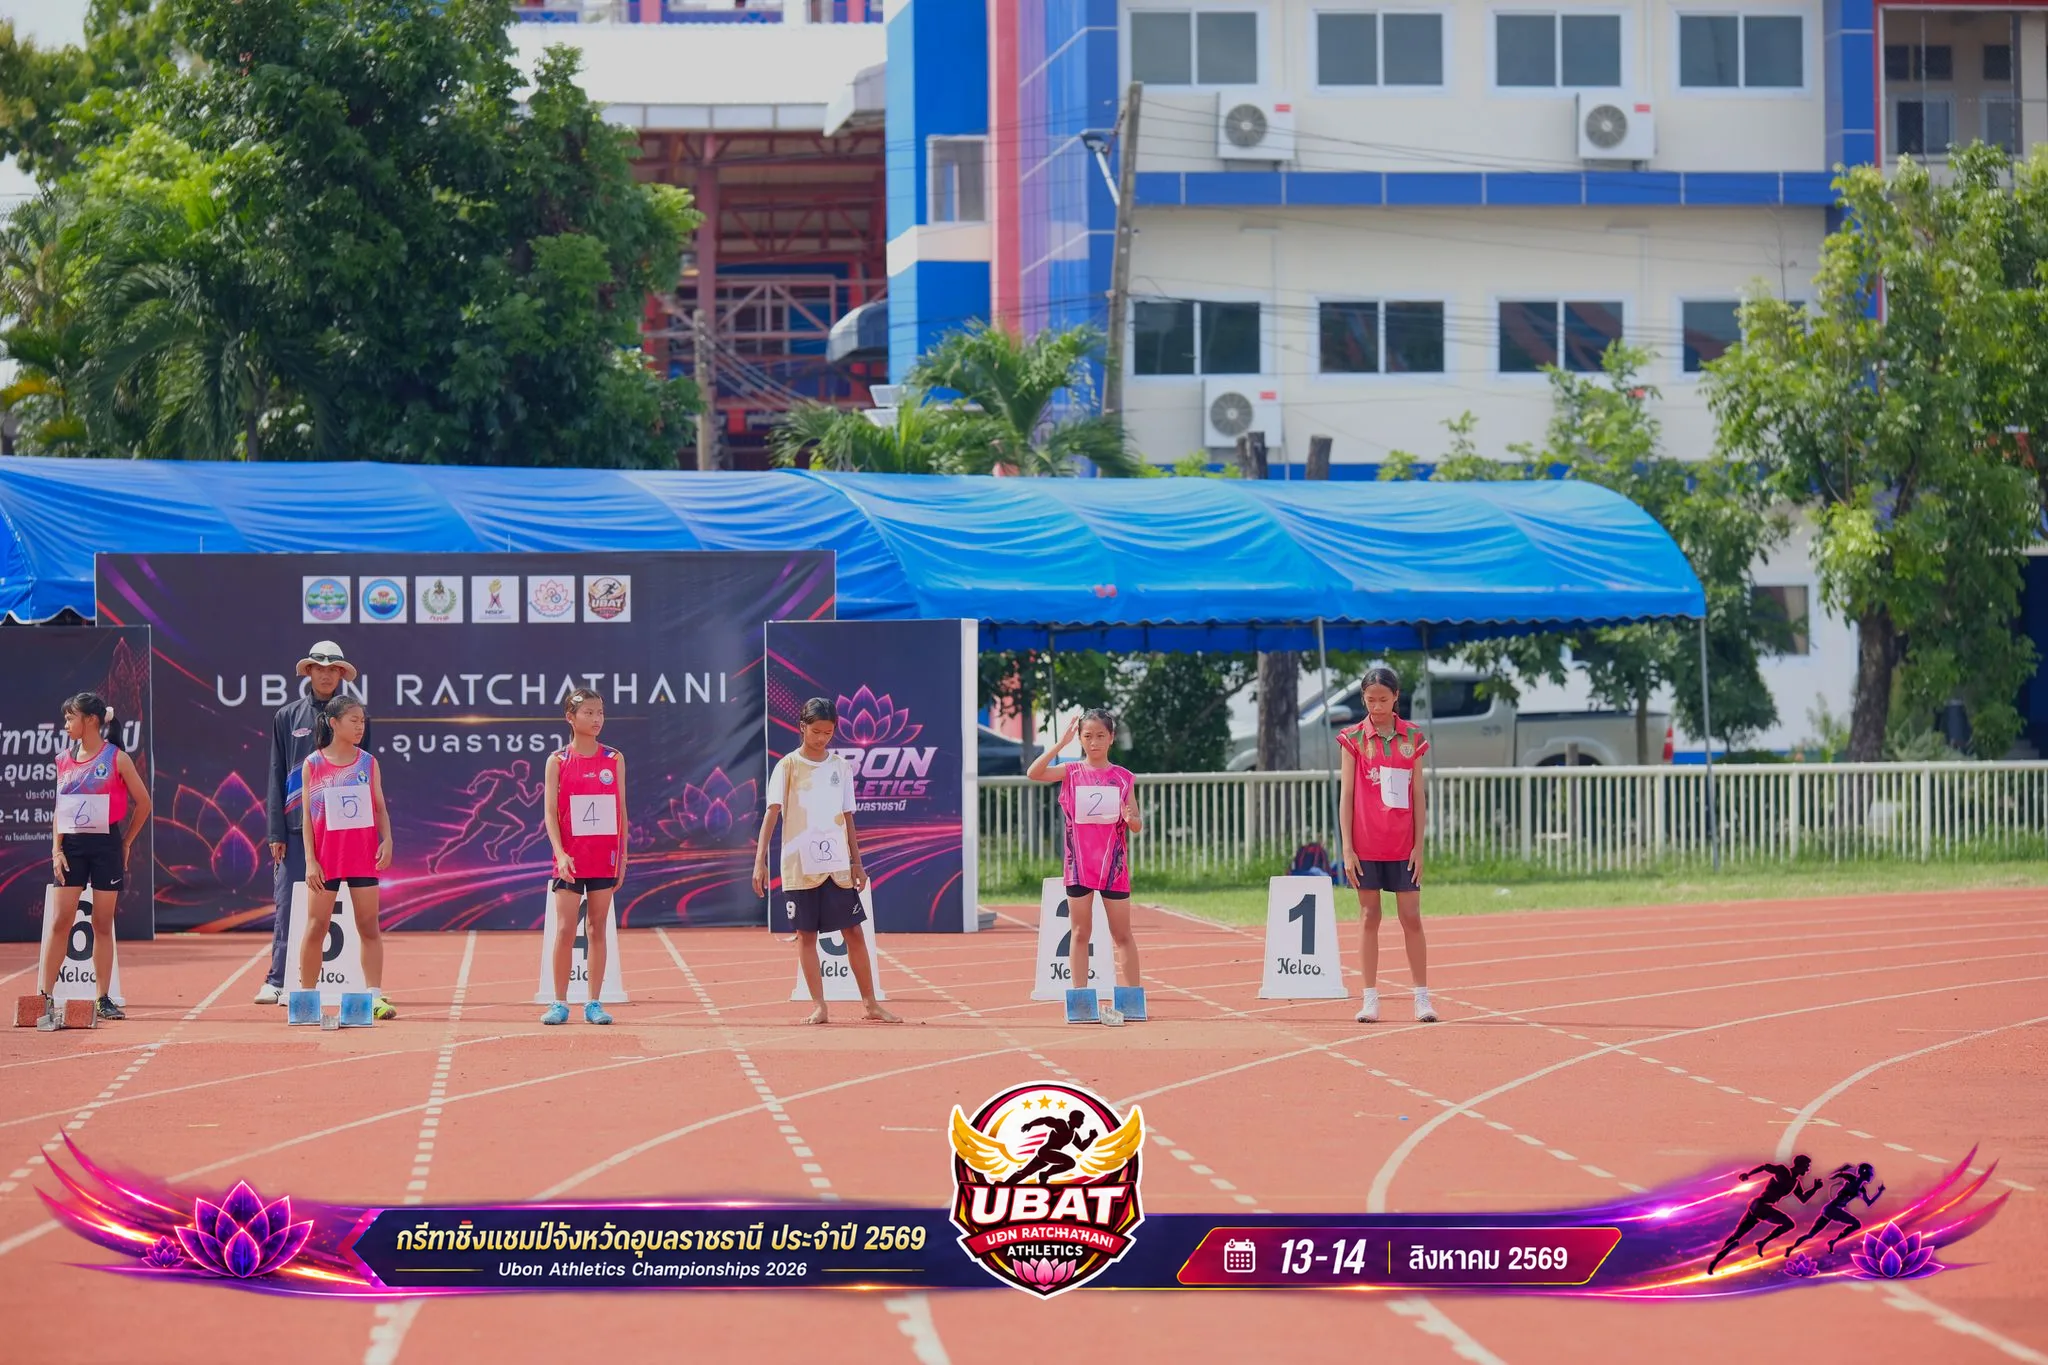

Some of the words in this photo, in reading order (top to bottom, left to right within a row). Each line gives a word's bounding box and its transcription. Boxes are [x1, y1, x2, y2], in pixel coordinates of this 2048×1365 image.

[396, 672, 726, 705] RATCHATHANI
[826, 747, 938, 777] BON
[854, 780, 933, 796] LETICS
[1387, 775, 1399, 796] 1
[74, 801, 90, 826] 6
[342, 795, 358, 818] 5
[582, 801, 600, 826] 4
[856, 799, 907, 812] บลราชธานี
[1087, 792, 1103, 816] 2
[818, 840, 833, 861] 3
[66, 900, 94, 961] 6
[1288, 894, 1316, 955] 1
[1050, 963, 1095, 980] Neo
[1277, 957, 1322, 975] Nelco
